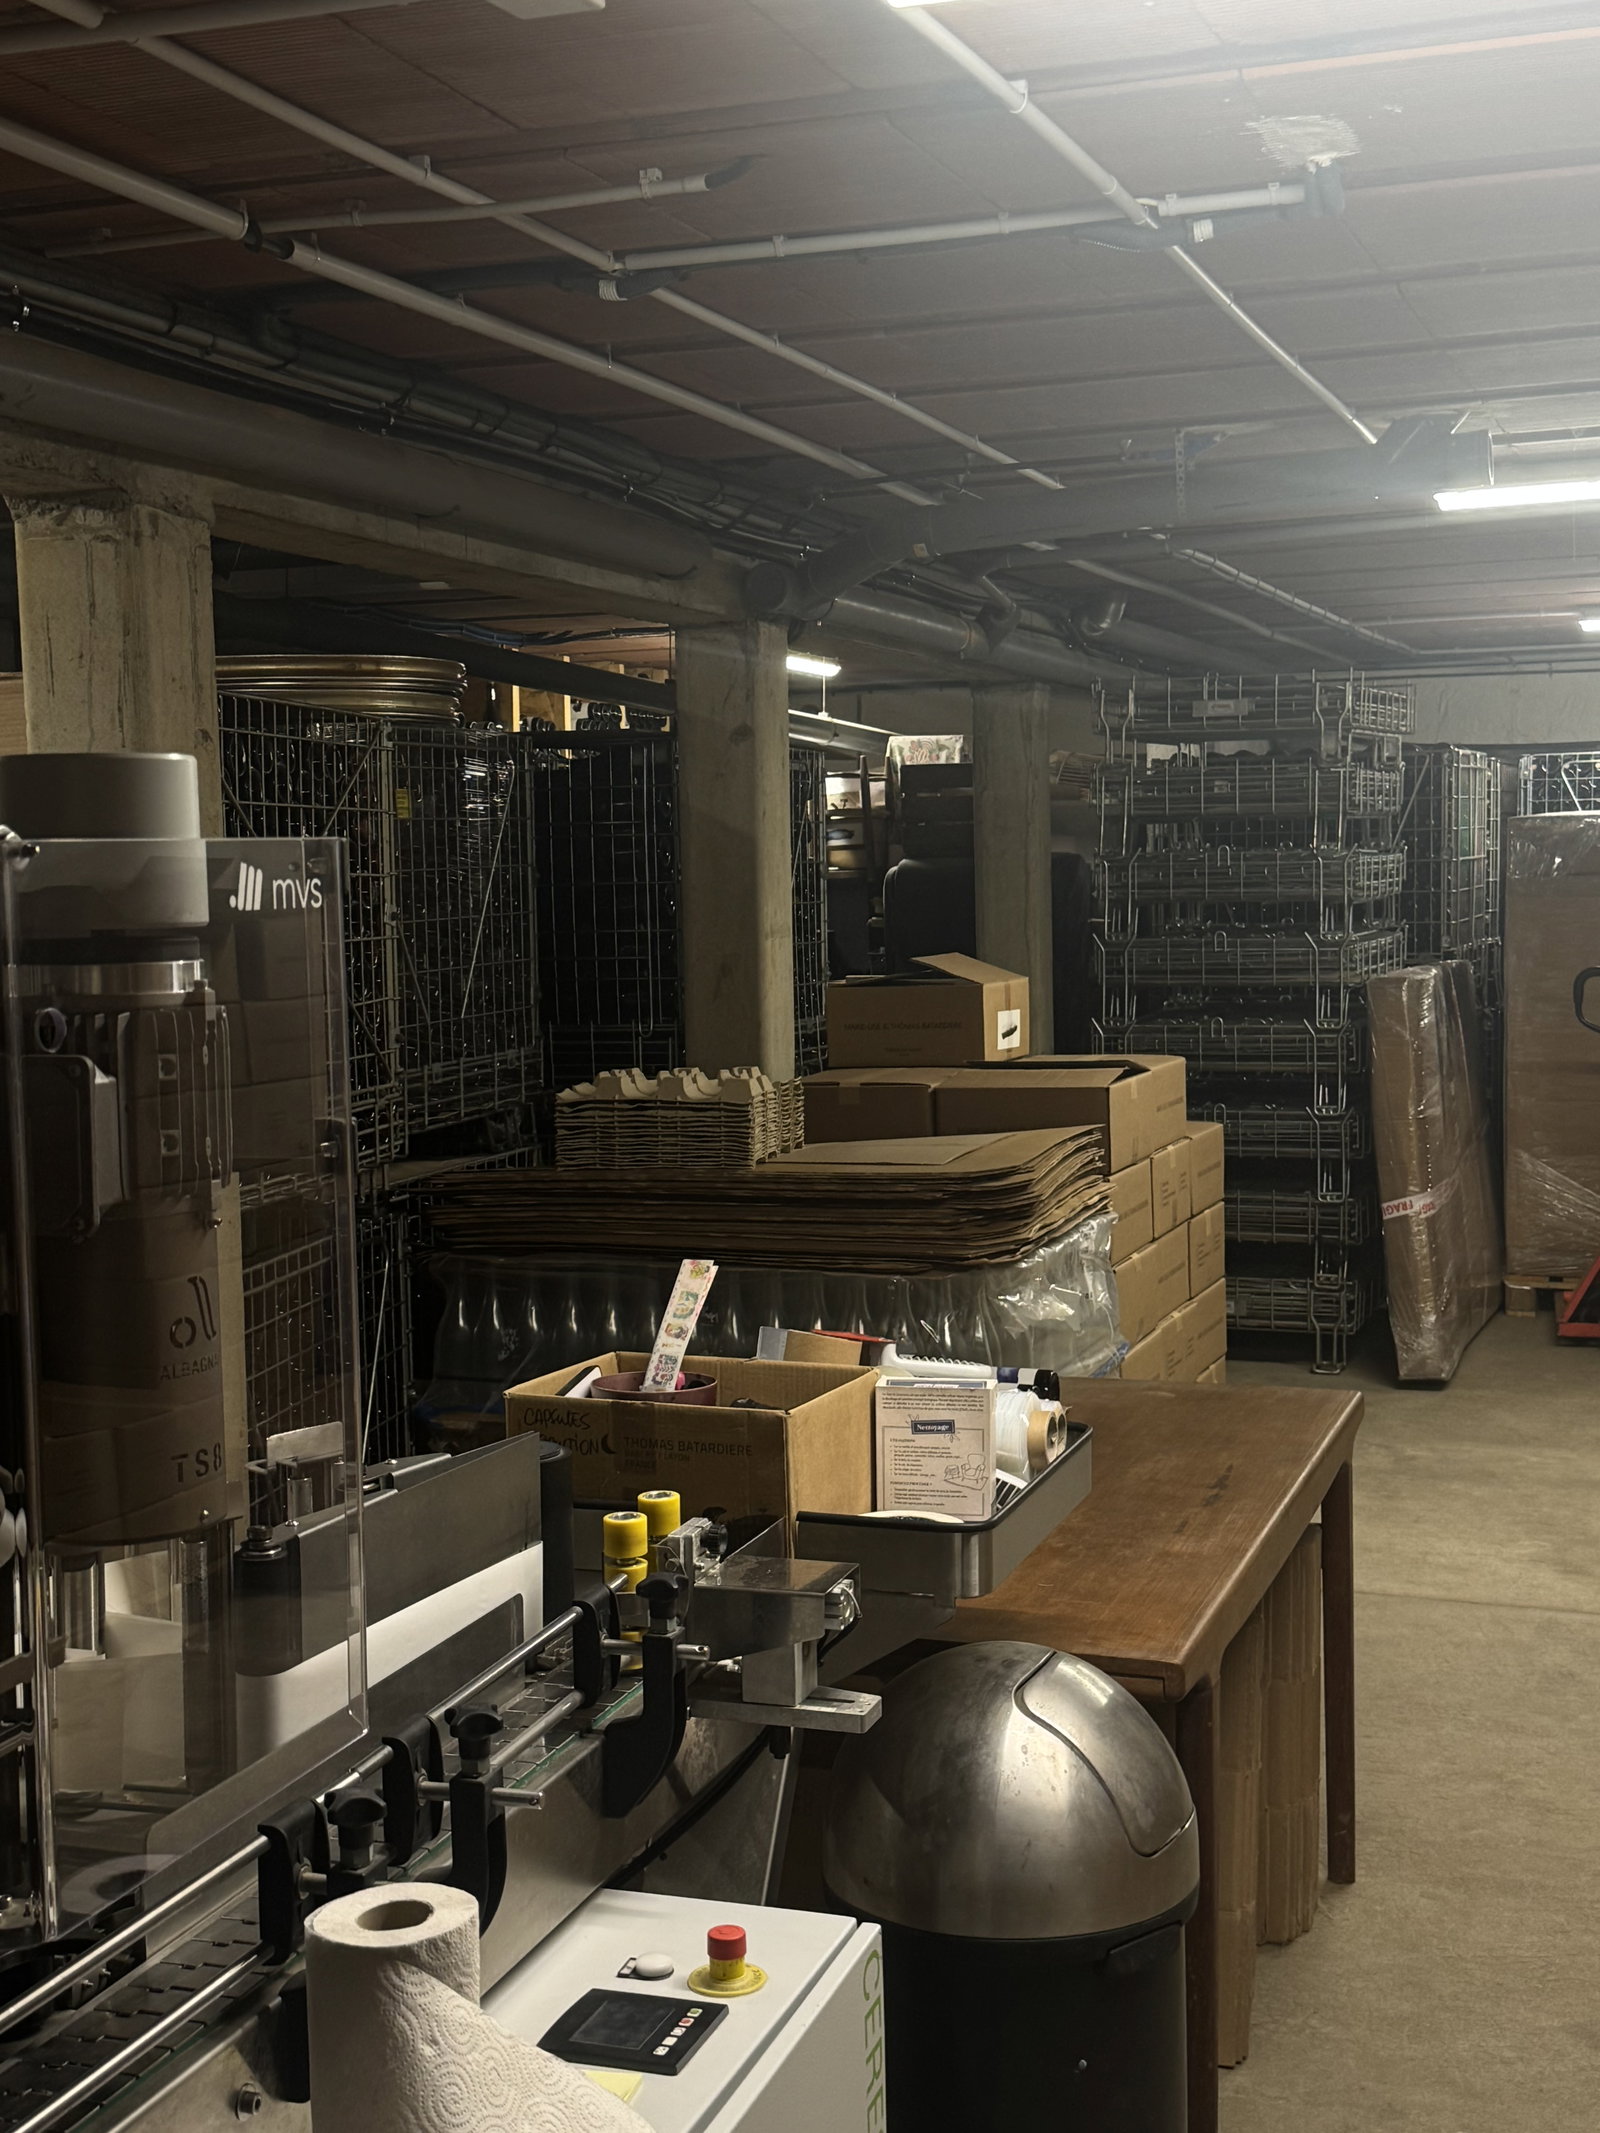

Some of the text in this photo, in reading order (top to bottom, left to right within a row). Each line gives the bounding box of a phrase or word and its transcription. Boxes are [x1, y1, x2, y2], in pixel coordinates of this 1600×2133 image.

[272, 878, 322, 910] mvs
[916, 1423, 950, 1432] Nettoyage
[623, 1436, 675, 1451] THOMAS
[678, 1439, 753, 1457] BATARDIERE
[862, 1949, 884, 2133] CERE
